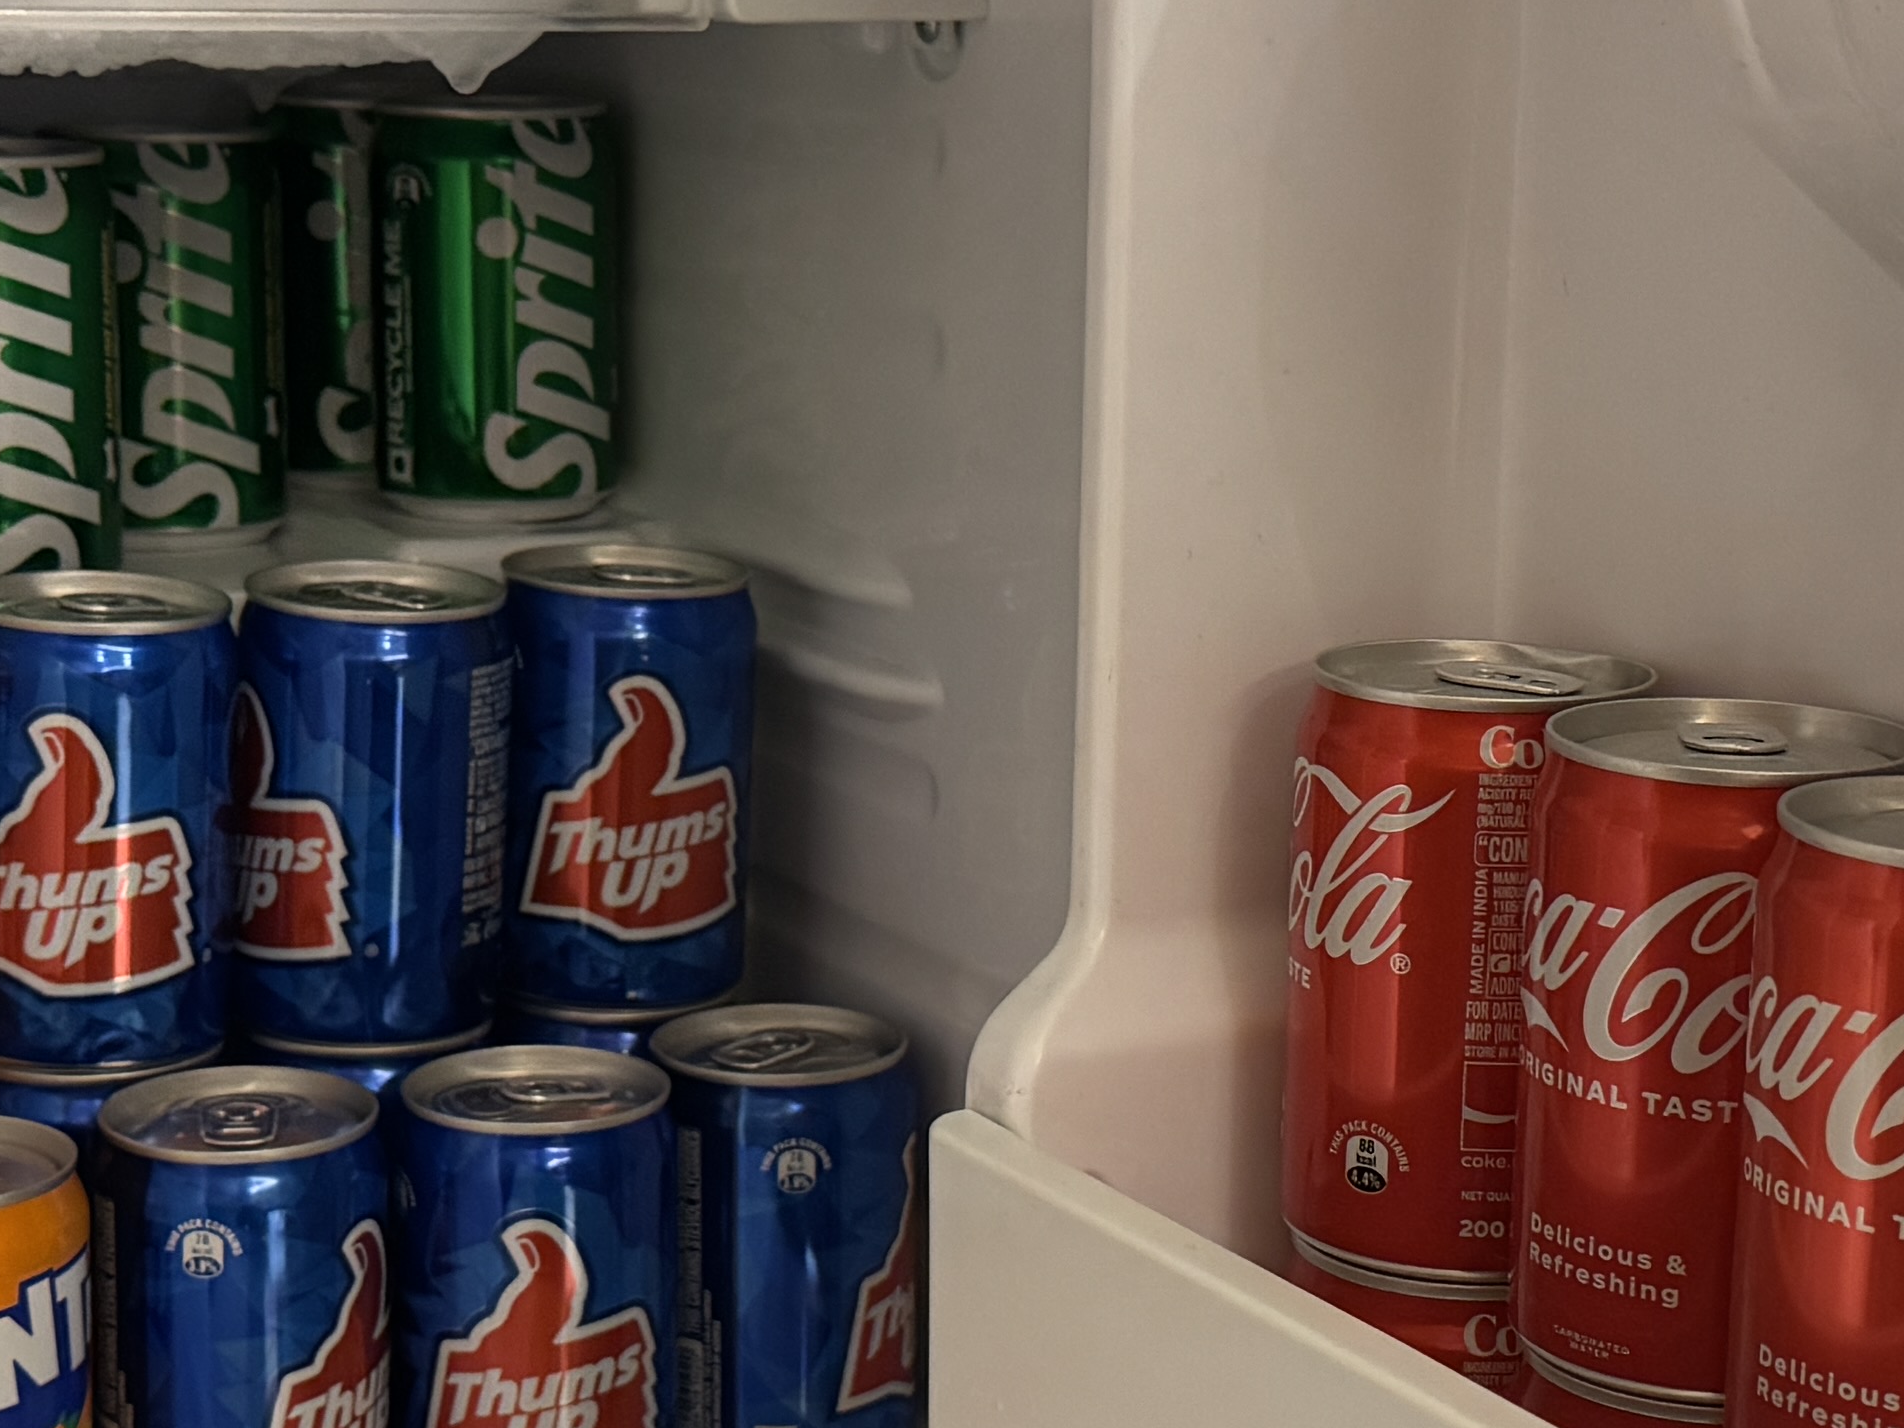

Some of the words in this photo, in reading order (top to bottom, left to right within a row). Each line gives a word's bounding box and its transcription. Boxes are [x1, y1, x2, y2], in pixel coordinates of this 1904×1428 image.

[475, 115, 610, 499] Sprite
[110, 142, 260, 529] Sprite
[1480, 725, 1544, 769] Co
[549, 800, 728, 874] Thums
[1473, 868, 1488, 915] INDIA
[1472, 921, 1486, 938] IN
[1289, 955, 1311, 989] TE
[1470, 944, 1484, 994] MADE
[1465, 1022, 1491, 1042] MRP
[1466, 1001, 1489, 1021] FOR
[1464, 1045, 1496, 1058] STORE
[1641, 1090, 1739, 1125] TAST
[1330, 1130, 1344, 1154] THIS
[1342, 1120, 1368, 1135] PACK
[1370, 1123, 1410, 1172] CONTAINS
[1359, 1138, 1375, 1154] 88
[1460, 1190, 1483, 1202] NET
[1742, 1154, 1875, 1237] ORIGINAL
[1459, 1220, 1505, 1238] 200
[1529, 1210, 1654, 1272] Delicious
[1665, 1251, 1688, 1277] &
[1527, 1240, 1682, 1311] Refreshing
[1463, 1314, 1523, 1357] Co
[1552, 1324, 1631, 1355] CARBONATED
[446, 1342, 643, 1427] Thums
[1758, 1342, 1902, 1413] Delicious
